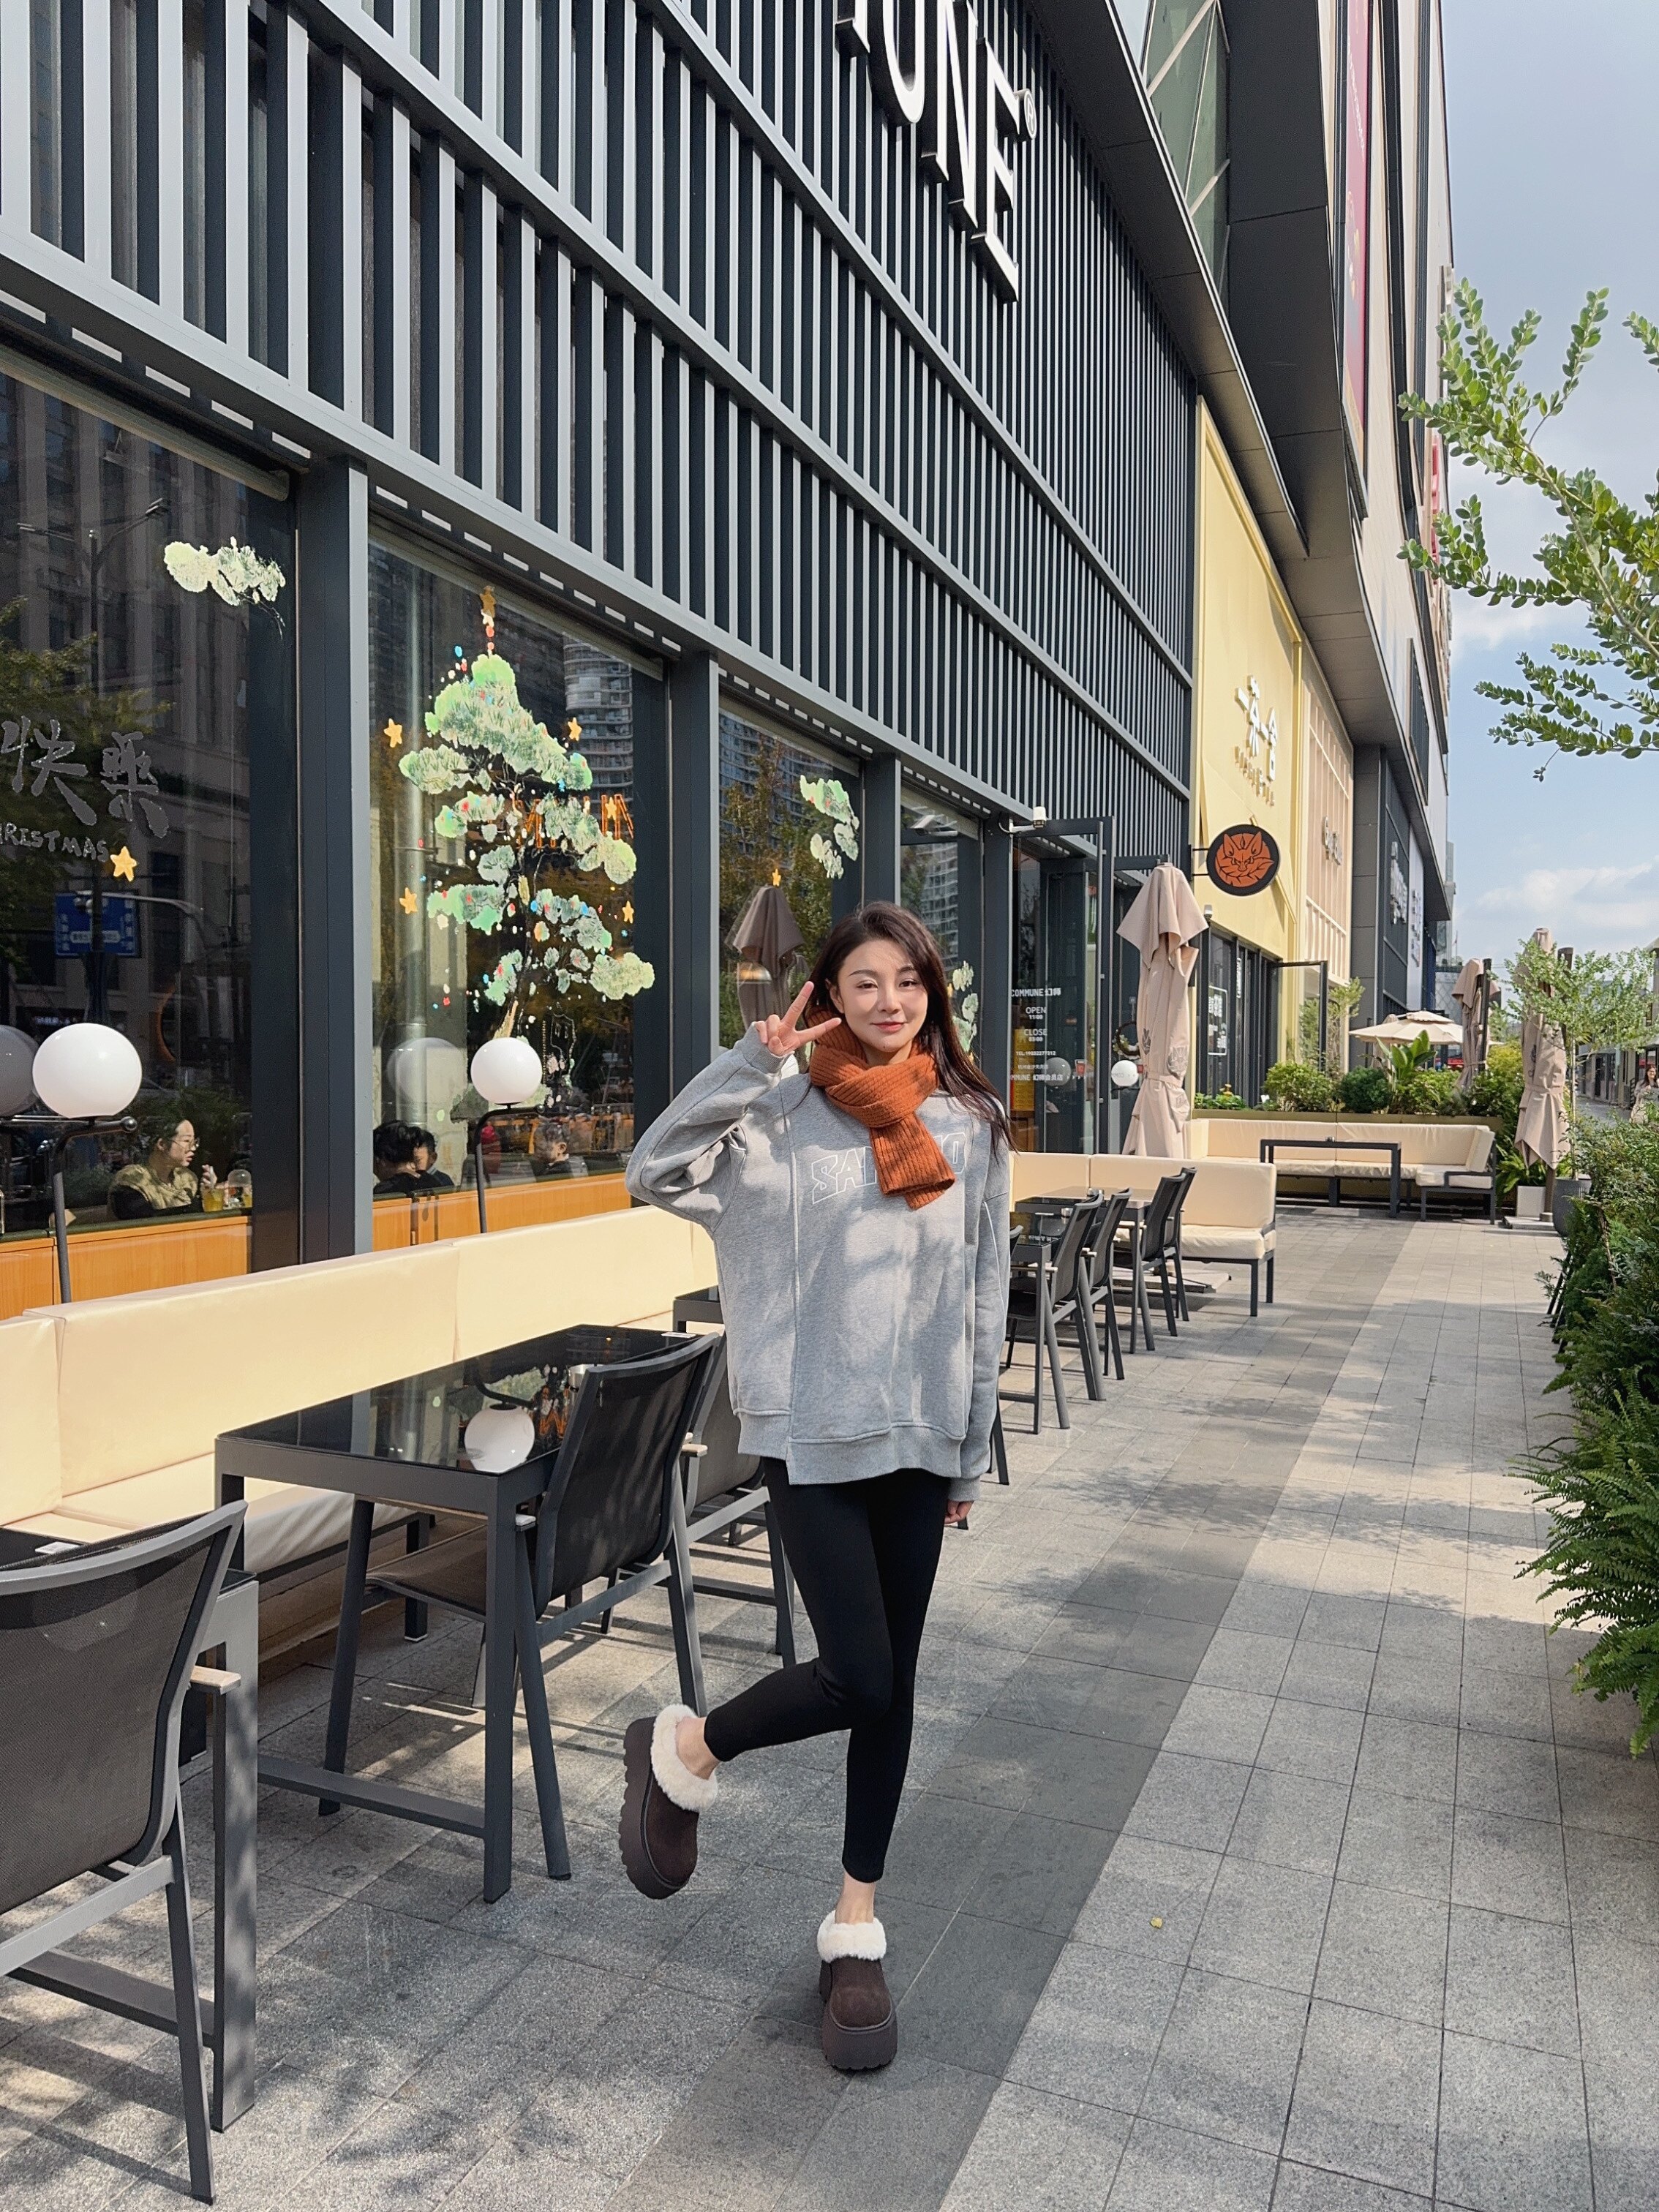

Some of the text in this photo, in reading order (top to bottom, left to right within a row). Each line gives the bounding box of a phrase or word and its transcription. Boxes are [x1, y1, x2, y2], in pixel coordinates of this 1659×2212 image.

[852, 0, 1020, 301] UNE
[0, 821, 109, 862] RISTMAS
[1011, 988, 1044, 997] COMMUNE
